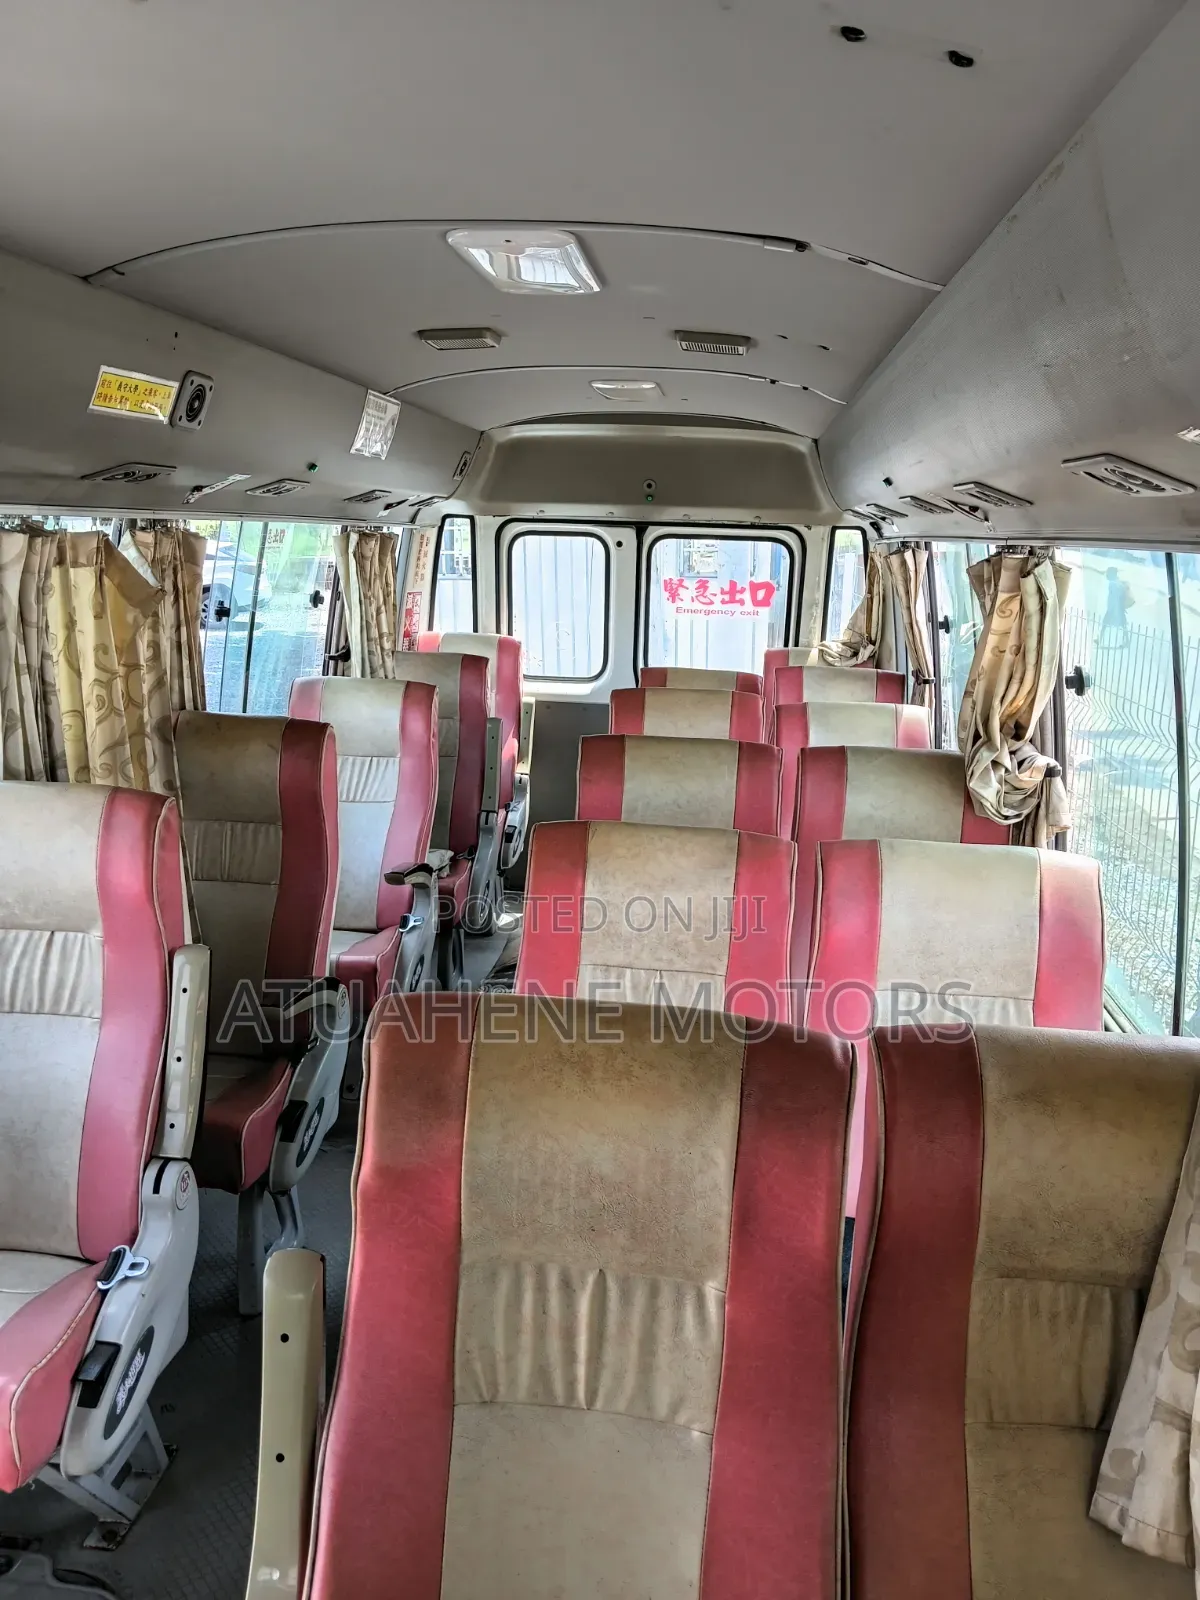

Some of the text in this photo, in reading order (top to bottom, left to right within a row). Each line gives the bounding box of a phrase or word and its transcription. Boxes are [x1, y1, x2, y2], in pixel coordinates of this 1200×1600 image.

[662, 577, 776, 608] 緊急出口
[675, 606, 737, 616] Emergency
